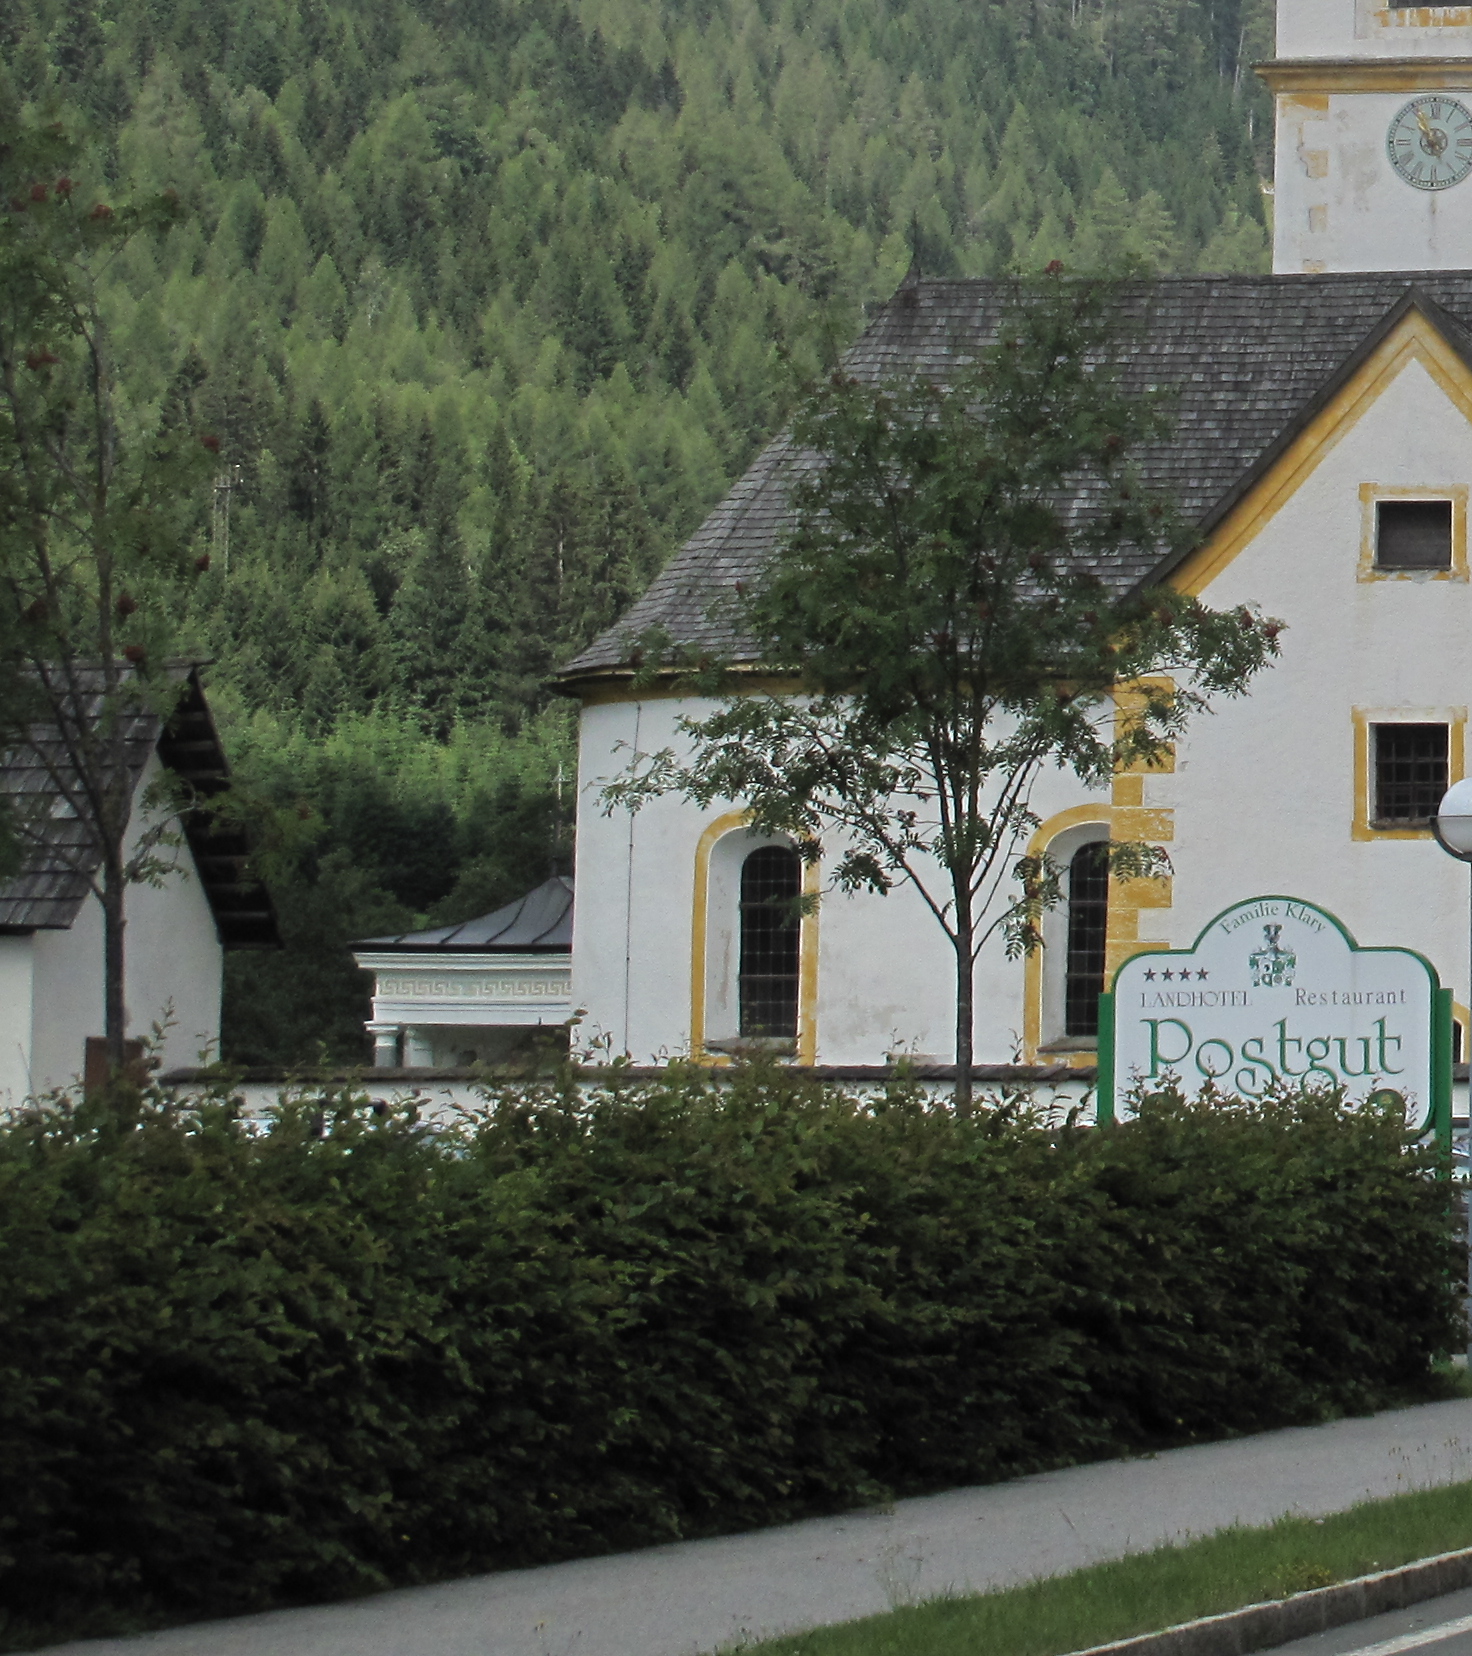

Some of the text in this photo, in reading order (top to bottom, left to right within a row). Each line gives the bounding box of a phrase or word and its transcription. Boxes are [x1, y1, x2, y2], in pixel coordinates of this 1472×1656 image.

[1219, 902, 1327, 935] Familie Klary
[1140, 987, 1408, 1009] LANDHOTEL Restaurant
[1140, 1015, 1406, 1100] Postgut
